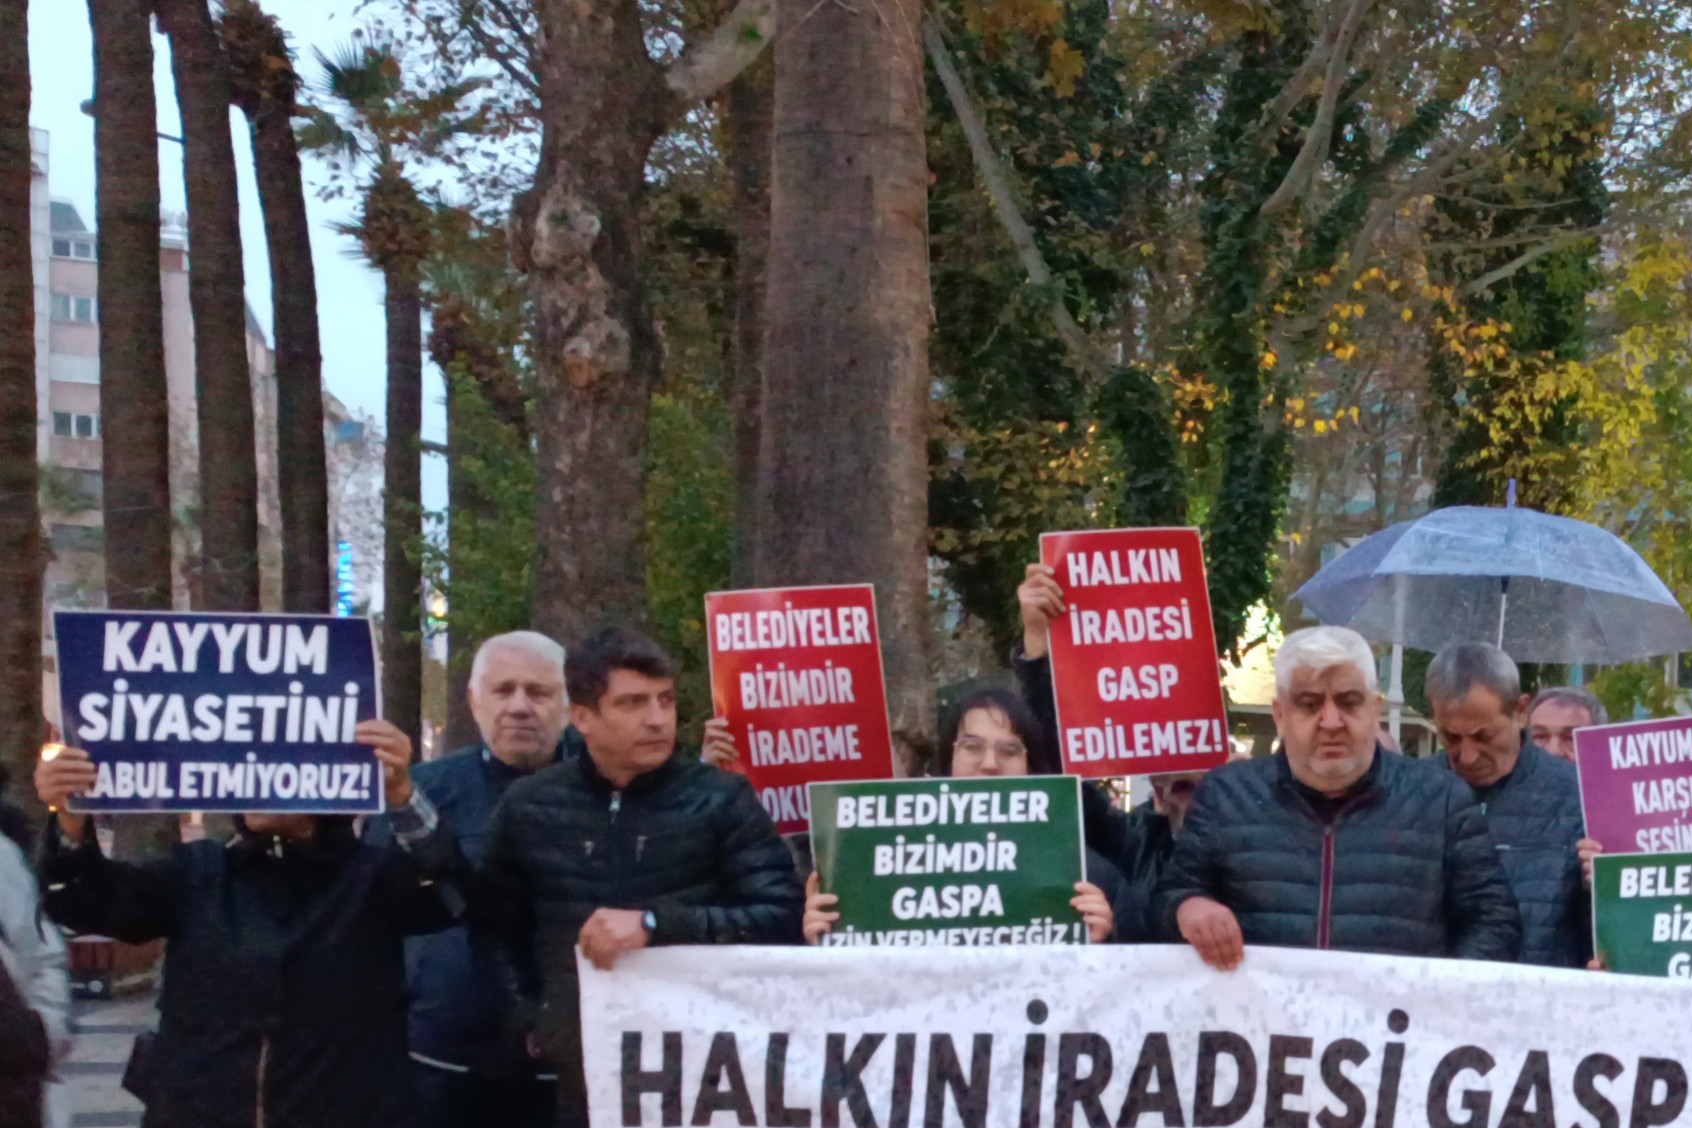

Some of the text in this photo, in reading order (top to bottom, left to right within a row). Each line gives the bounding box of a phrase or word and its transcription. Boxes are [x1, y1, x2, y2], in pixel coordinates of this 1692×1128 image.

[1066, 547, 1181, 587] HALKIN
[715, 601, 871, 652] BELEDİYELER
[1070, 597, 1193, 646] İRADESİ
[103, 620, 329, 675] KAYYUM
[740, 660, 855, 710] BİZİMDİR
[1098, 663, 1179, 702] GASP
[78, 678, 360, 744] SİYASETİNİ
[747, 723, 862, 767] İRADEME
[1066, 715, 1223, 763] EDİLEMEZ!
[84, 752, 371, 800] ABUL ETMİYORUZ!
[757, 784, 809, 822] OKU
[836, 783, 1049, 829] BELEDİYELER
[873, 832, 1019, 876] BİZİMDİR
[892, 884, 1004, 921] GASPA
